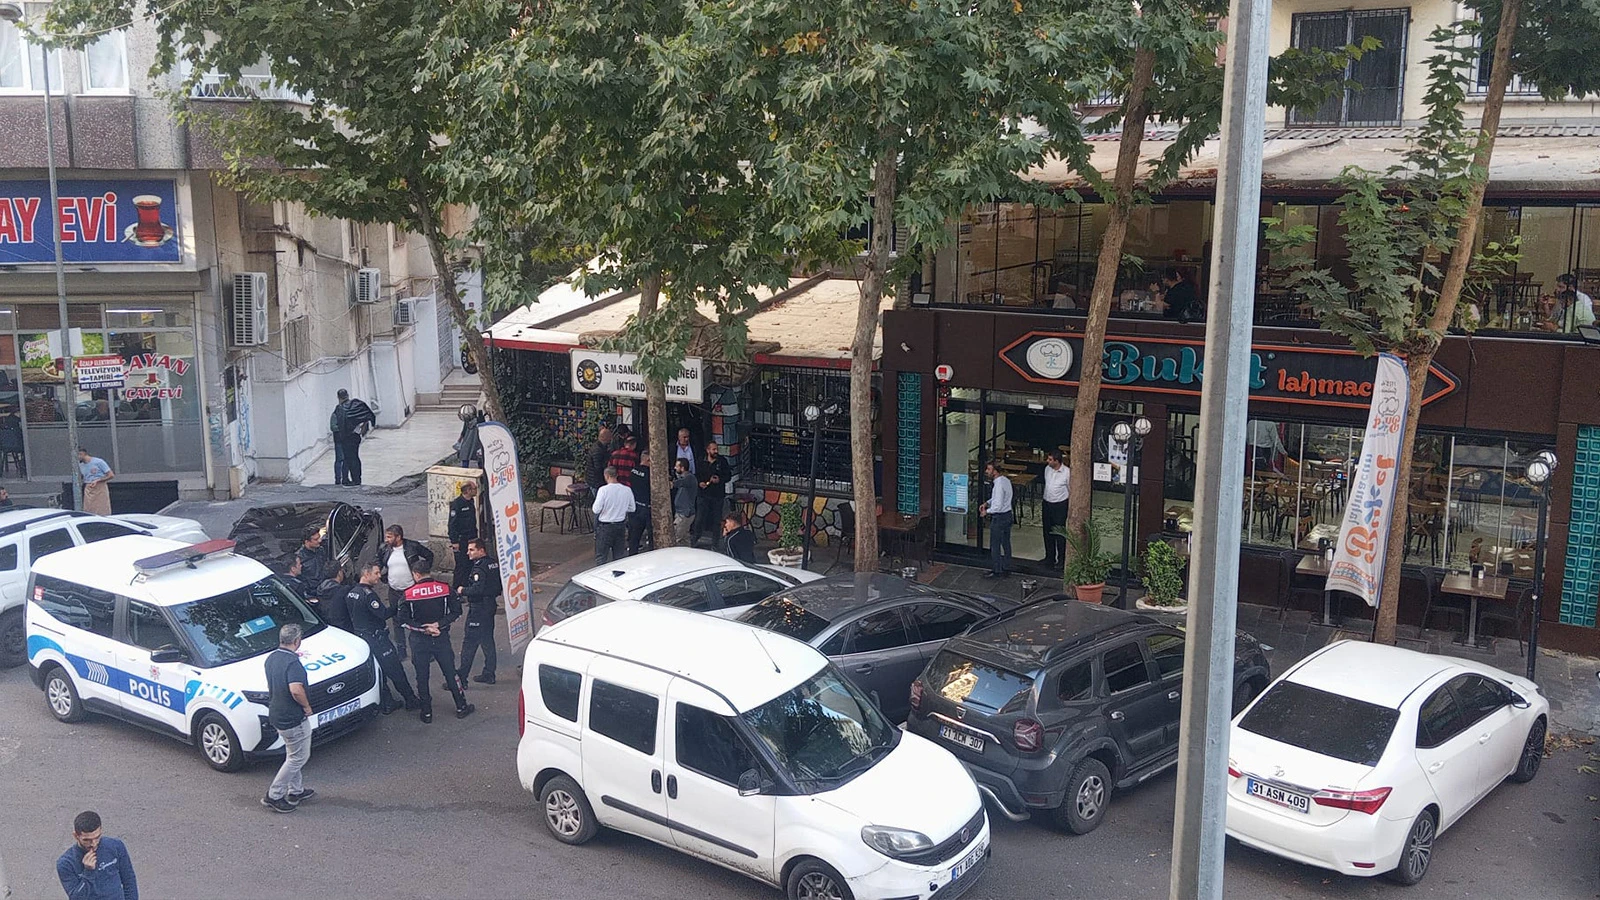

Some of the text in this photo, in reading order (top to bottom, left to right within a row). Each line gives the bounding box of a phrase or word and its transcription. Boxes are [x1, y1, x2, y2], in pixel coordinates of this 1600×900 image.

[80, 366, 121, 375] TELEVİZYON
[90, 373, 113, 381] TAMİRİ
[1101, 341, 1373, 397] Bukt lahmac
[126, 385, 183, 402] ÇAY EVİ
[616, 379, 688, 396] İKTİSAD TMESİ
[412, 584, 444, 597] POLİS
[304, 652, 346, 671] OLİS
[129, 678, 171, 707] POLİS
[332, 709, 340, 720] A
[943, 726, 951, 738] 21
[969, 737, 983, 749] 307
[1253, 783, 1263, 794] 31
[1266, 788, 1285, 801] ASN
[1287, 794, 1306, 808] 409
